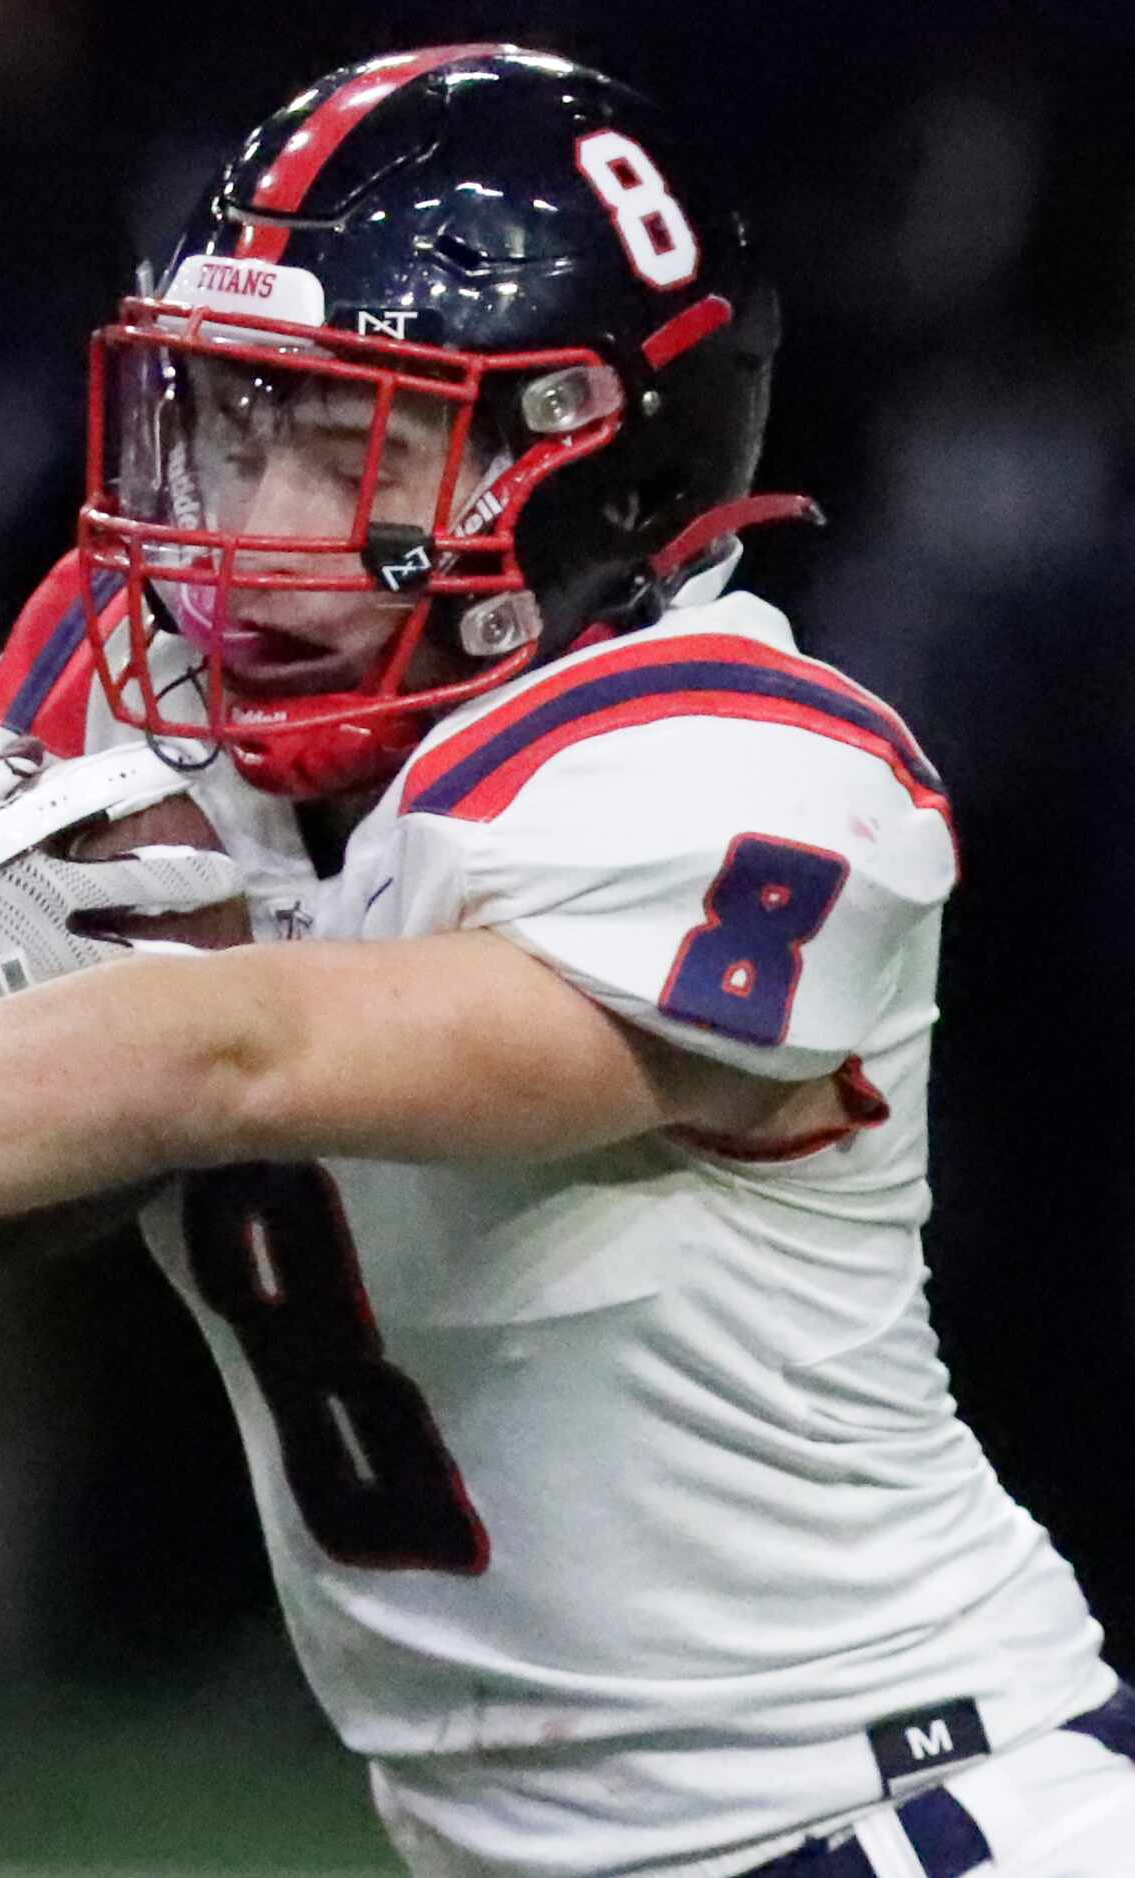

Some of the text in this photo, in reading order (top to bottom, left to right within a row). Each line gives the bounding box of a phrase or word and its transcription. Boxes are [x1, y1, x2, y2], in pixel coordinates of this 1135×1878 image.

[197, 262, 277, 299] TITANS
[575, 128, 702, 291] 8
[657, 831, 850, 1048] 8
[177, 1158, 491, 1578] 8
[904, 1718, 954, 1761] M
